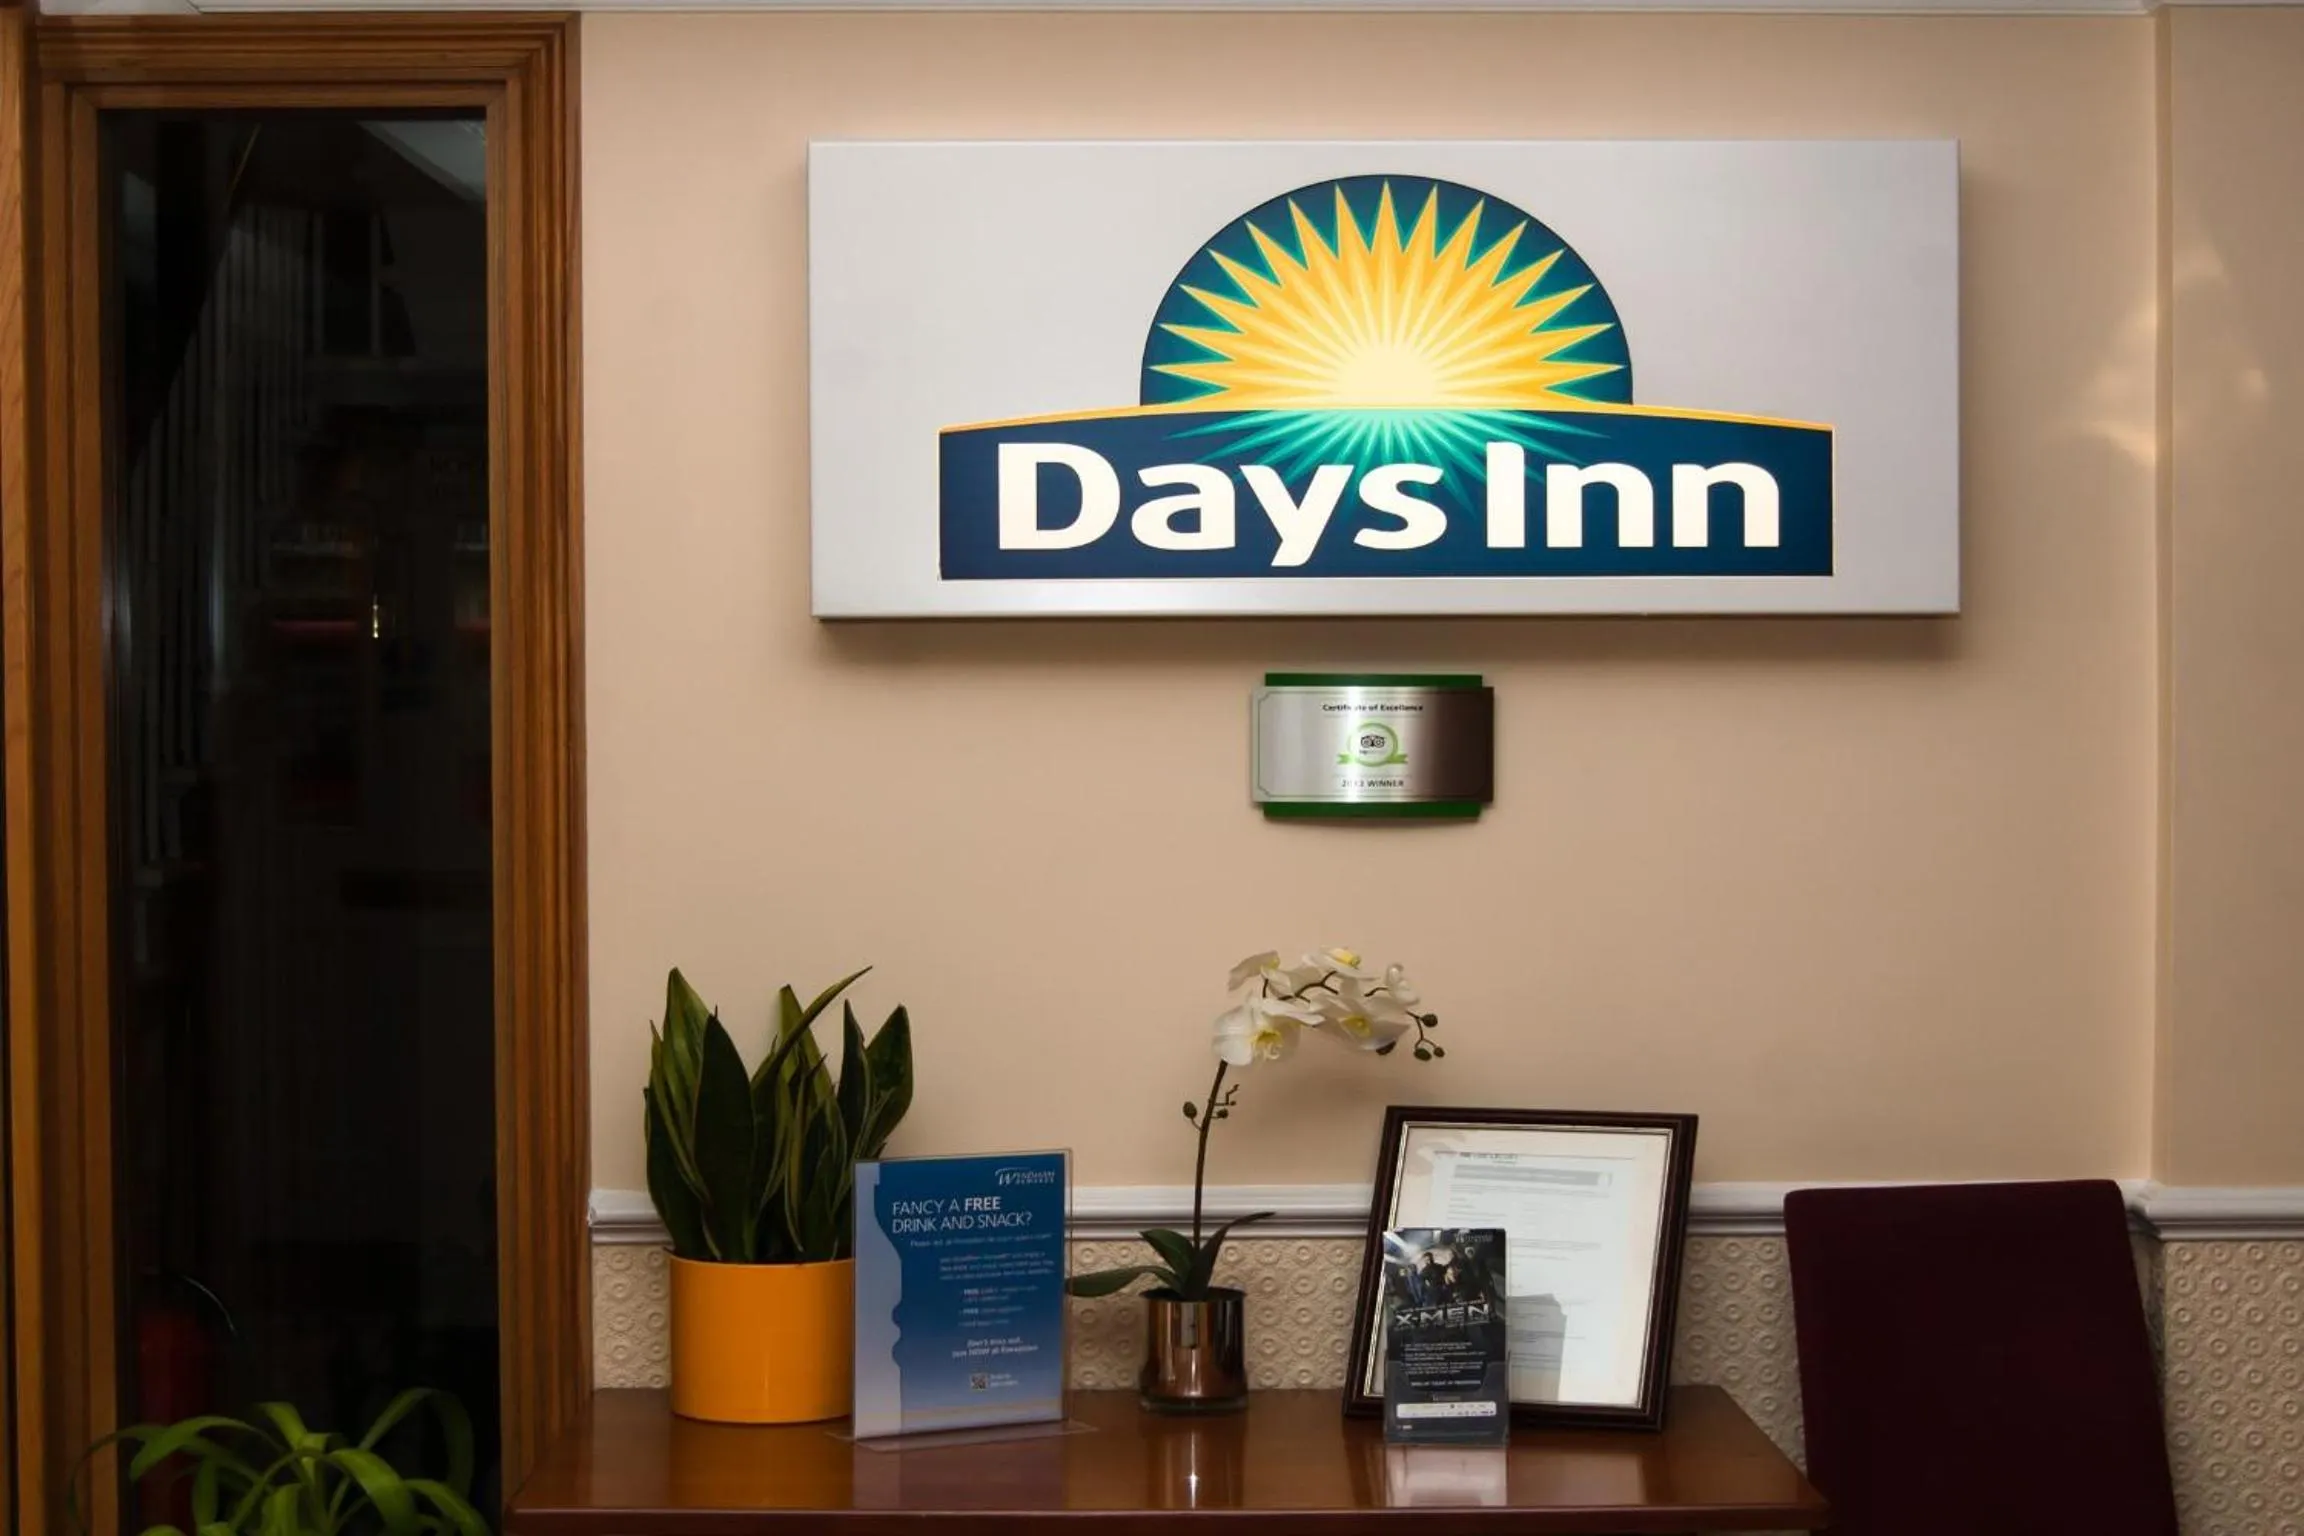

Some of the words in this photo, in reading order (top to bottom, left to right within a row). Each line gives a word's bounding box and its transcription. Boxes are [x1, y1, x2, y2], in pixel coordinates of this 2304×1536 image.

[998, 443, 1447, 566] Days
[1486, 442, 1780, 548] Inn
[1322, 703, 1367, 712] Certifiate
[1368, 704, 1379, 712] of
[1380, 703, 1424, 712] Excellence
[1367, 779, 1405, 788] WINNER
[892, 1199, 945, 1216] FANCY
[948, 1199, 961, 1213] A
[964, 1196, 1002, 1212] FREE
[892, 1217, 938, 1234] DRINK
[940, 1215, 975, 1231] AND
[978, 1211, 1033, 1229] SNACK?
[1395, 1303, 1490, 1327] X-MEN
